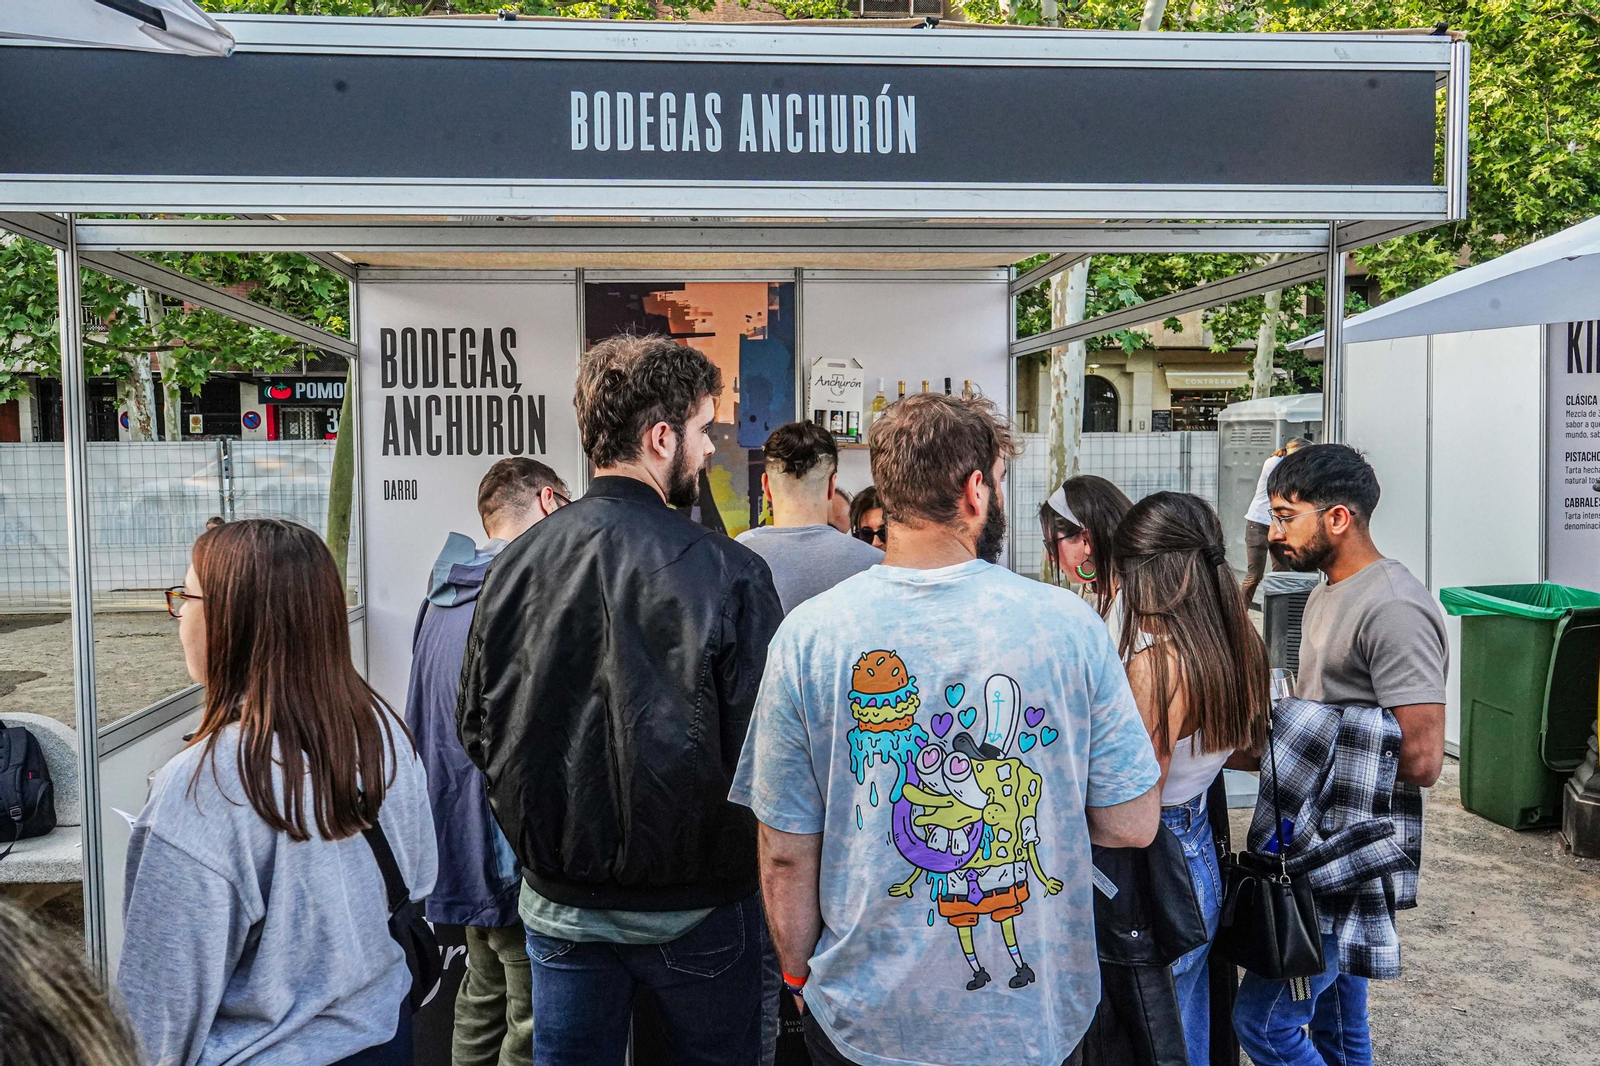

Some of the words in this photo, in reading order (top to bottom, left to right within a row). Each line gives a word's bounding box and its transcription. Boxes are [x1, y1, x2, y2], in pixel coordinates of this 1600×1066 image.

[570, 91, 721, 152] BODEGAS
[738, 83, 916, 154] ANCHURÓN
[1567, 320, 1600, 374] KI
[380, 326, 518, 390] BODEGAS
[815, 375, 862, 388] Anchurón
[295, 382, 347, 399] POMO
[1565, 393, 1598, 406] CLÁSICA
[382, 383, 547, 456] ANCHURÓN
[1565, 410, 1587, 418] Mezcla
[1588, 410, 1597, 418] de
[1565, 421, 1583, 429] sabor
[1565, 466, 1582, 474] Tarta
[1564, 477, 1587, 485] natural
[383, 479, 418, 501] DARRO
[1564, 497, 1600, 508] CABRALE
[1565, 512, 1581, 520] Tarta
